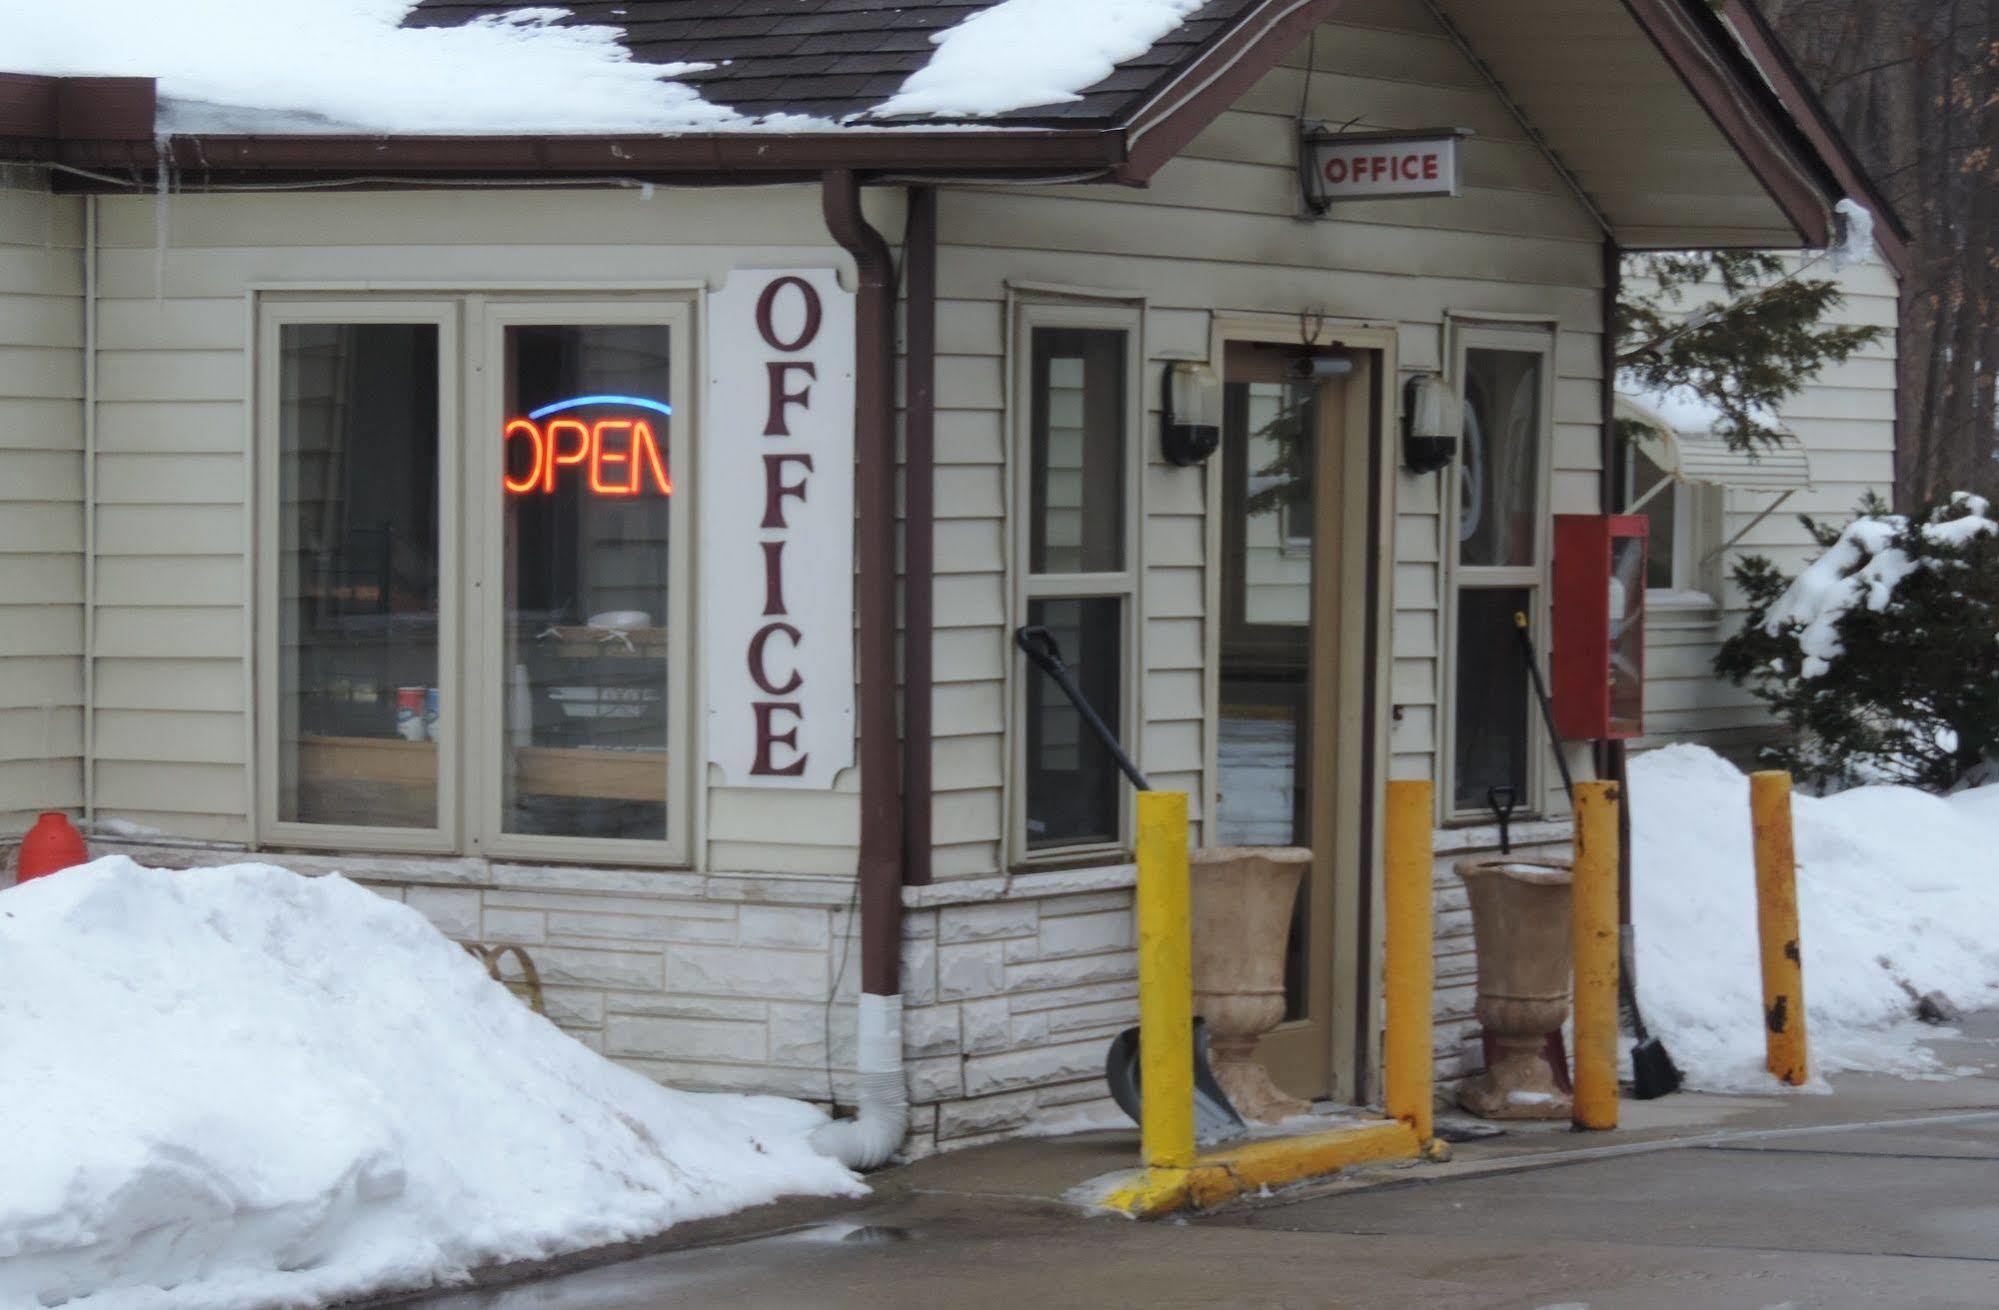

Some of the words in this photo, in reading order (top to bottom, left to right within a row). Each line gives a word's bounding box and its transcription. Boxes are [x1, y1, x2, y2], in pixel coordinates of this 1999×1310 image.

[1324, 155, 1439, 184] OFFICE
[503, 418, 673, 496] OPEN
[747, 275, 822, 776] OFFICE
